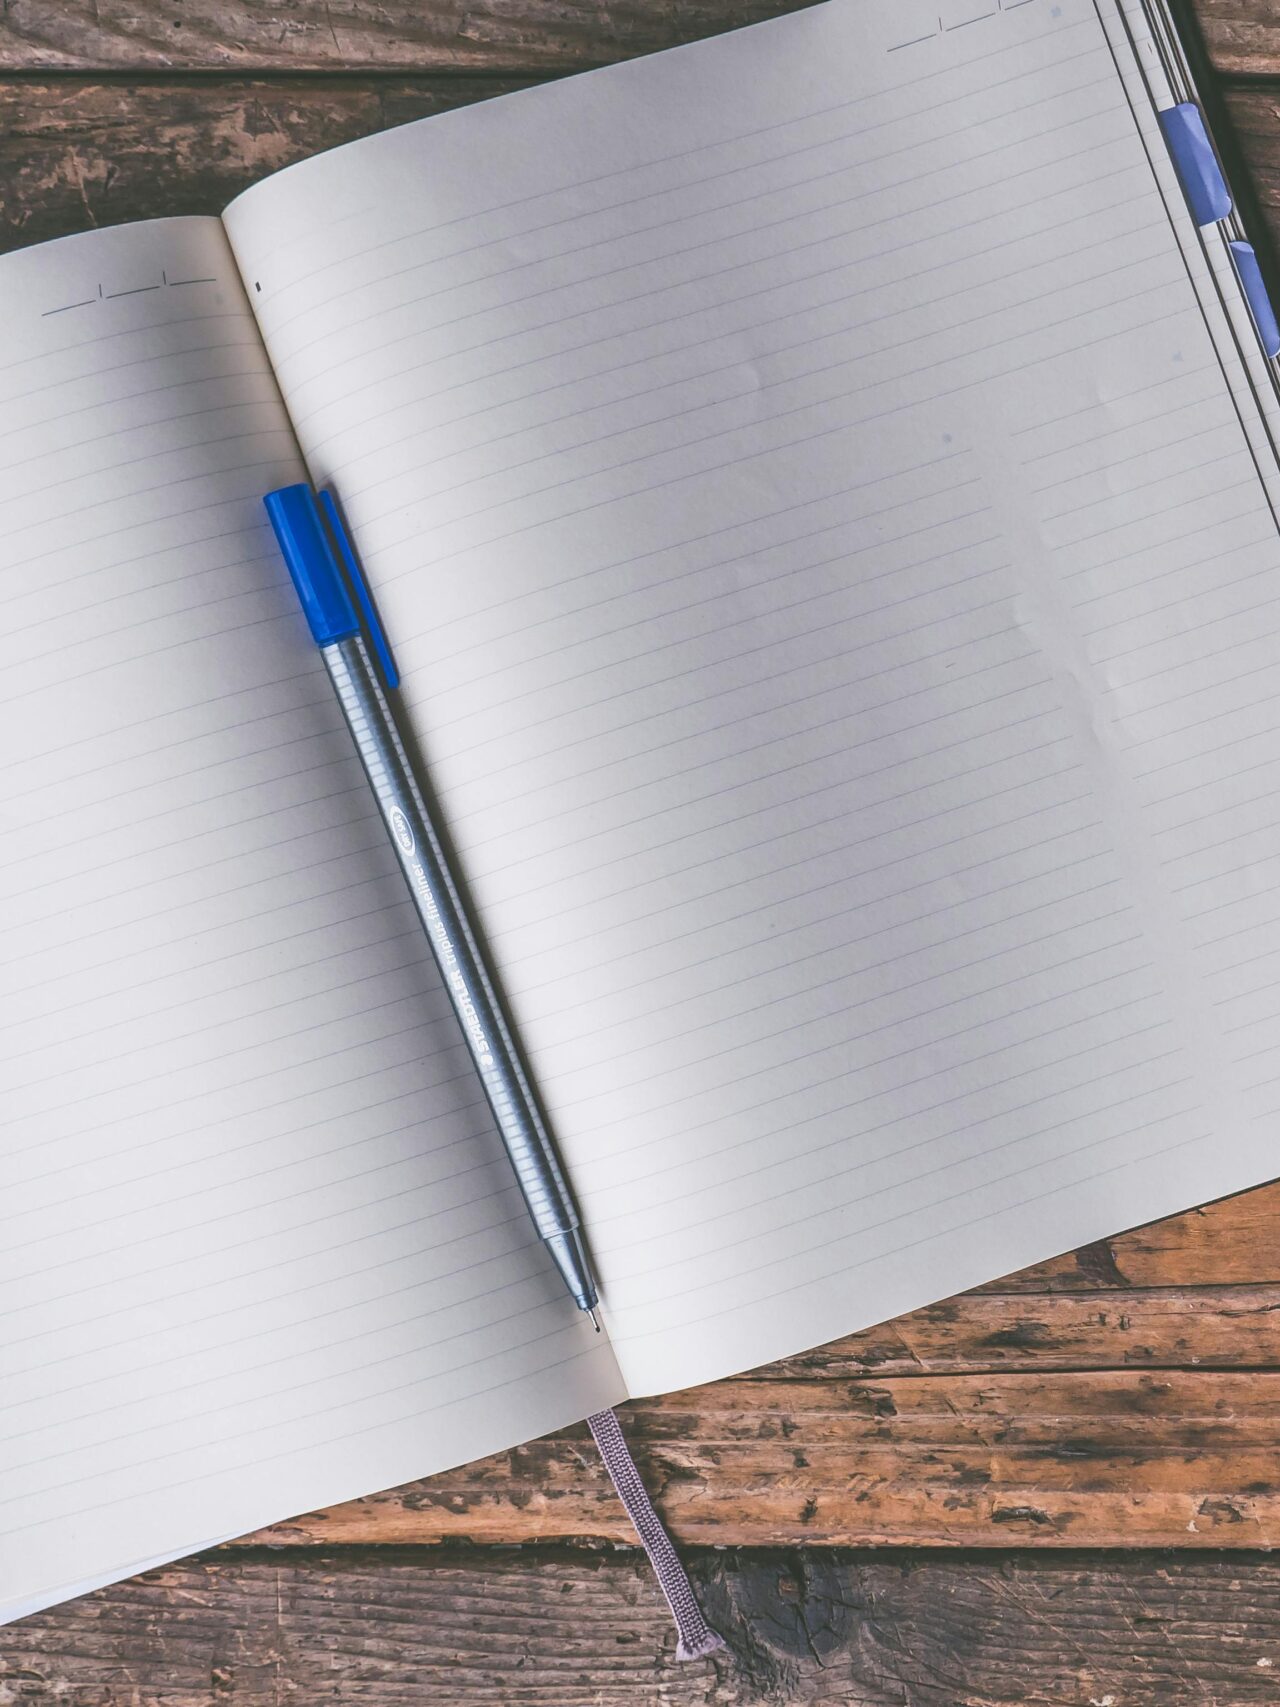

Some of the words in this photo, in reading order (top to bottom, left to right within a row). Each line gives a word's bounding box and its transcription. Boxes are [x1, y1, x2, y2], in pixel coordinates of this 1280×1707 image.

[393, 813, 405, 831] SAFE
[399, 831, 412, 848] DRY
[411, 863, 440, 921] fineliner
[434, 921, 456, 965] triplus
[451, 968, 490, 1052] STAEDTLER
